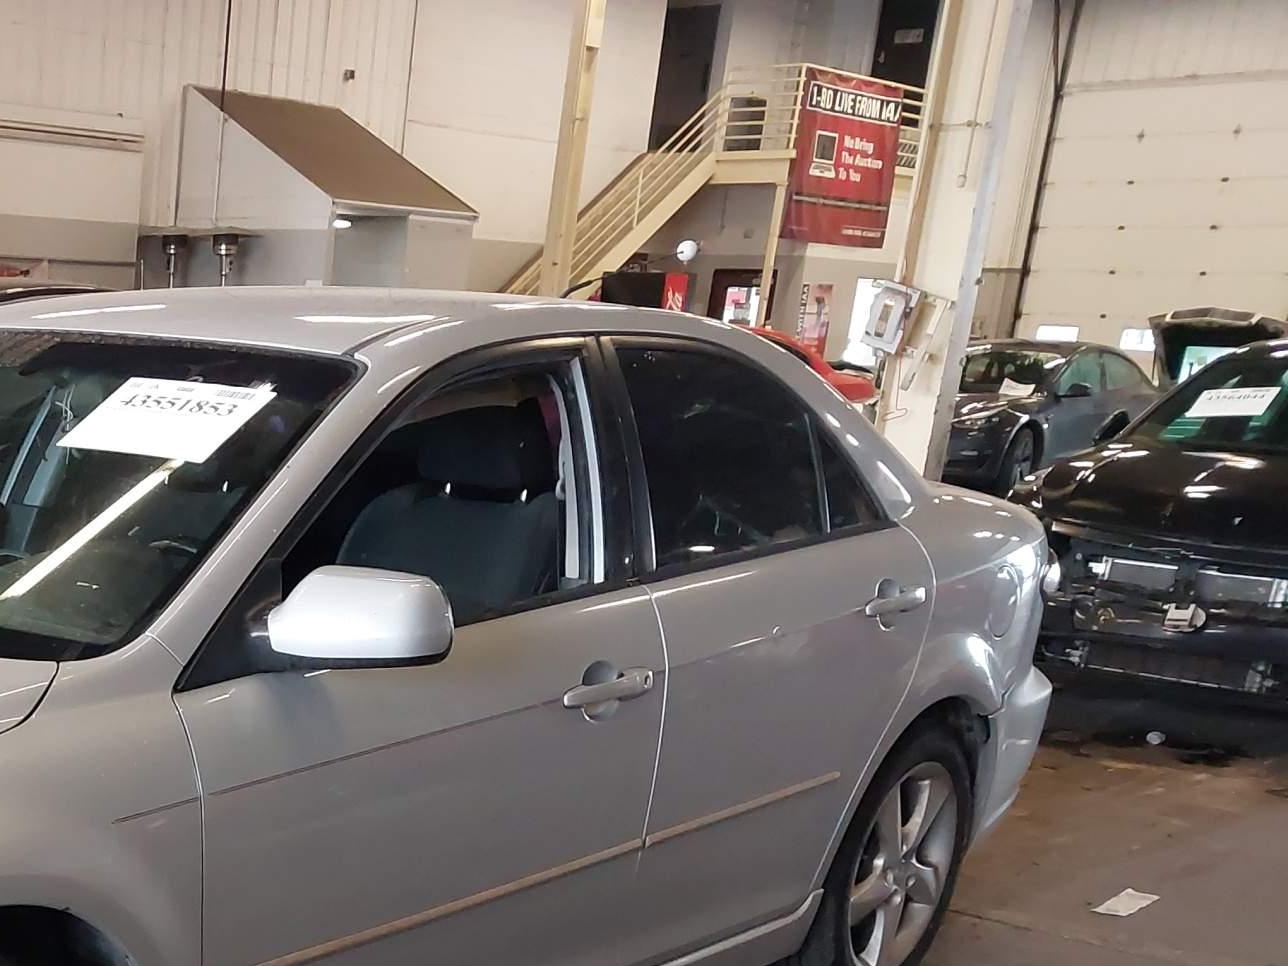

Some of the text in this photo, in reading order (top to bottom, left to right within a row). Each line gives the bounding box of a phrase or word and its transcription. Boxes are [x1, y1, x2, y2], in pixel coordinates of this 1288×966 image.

[834, 91, 855, 113] LIVE
[855, 95, 881, 119] FROM
[841, 151, 854, 165] The
[121, 393, 238, 416] 43551853
